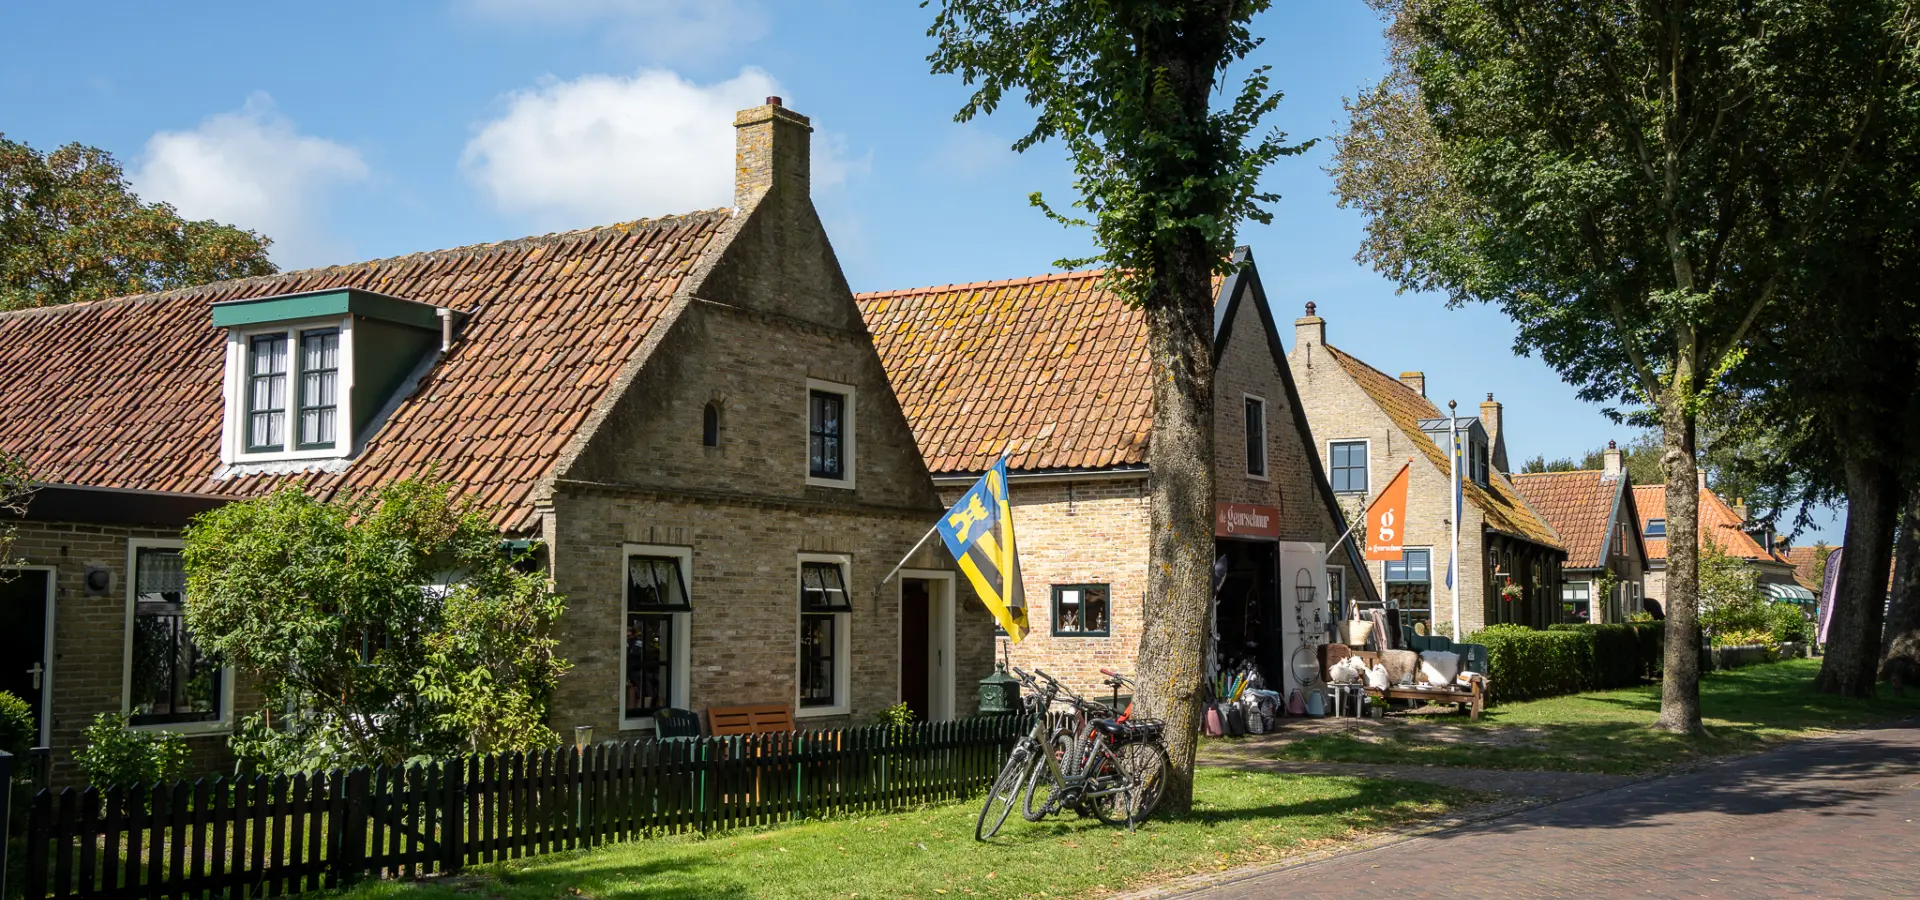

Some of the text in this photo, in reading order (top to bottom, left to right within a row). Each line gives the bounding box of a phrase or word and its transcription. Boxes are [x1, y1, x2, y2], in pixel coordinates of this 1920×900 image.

[1219, 505, 1269, 532] de geurschuur
[1379, 507, 1394, 541] g
